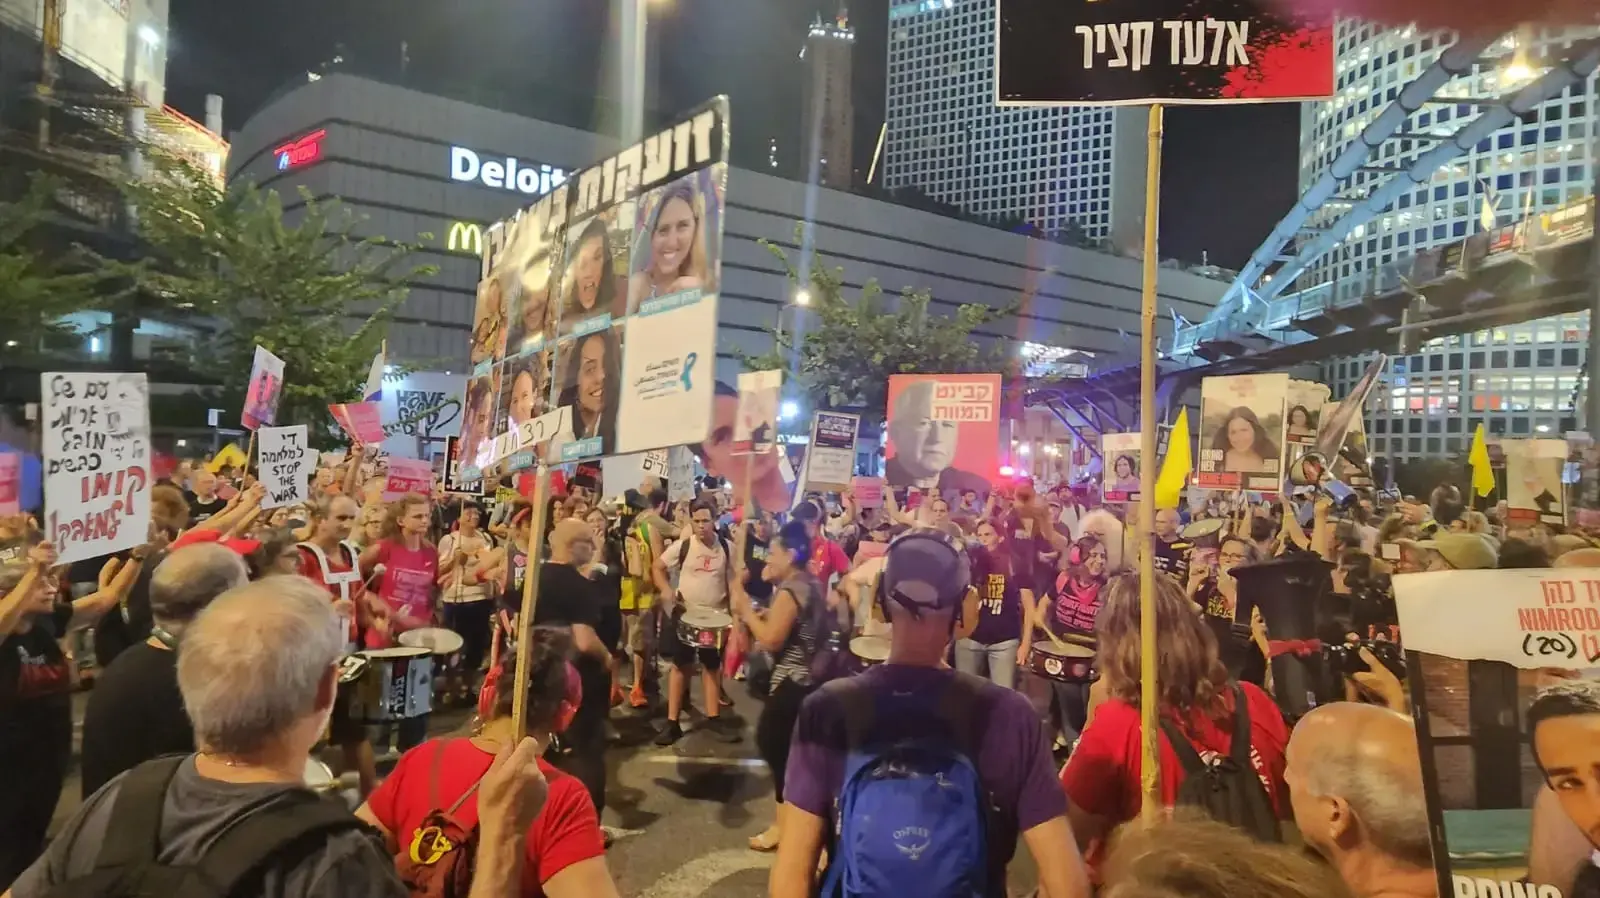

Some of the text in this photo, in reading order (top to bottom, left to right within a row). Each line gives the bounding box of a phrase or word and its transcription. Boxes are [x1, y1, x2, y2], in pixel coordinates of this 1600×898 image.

[1074, 17, 1250, 71] אלעד קציר
[573, 109, 714, 217] זועקות
[51, 374, 110, 400] עם של
[935, 384, 990, 400] קבינט
[934, 404, 989, 420] המוות
[281, 432, 298, 446] די
[261, 444, 305, 464] למלחמה
[271, 460, 302, 477] STOP
[80, 465, 147, 516] קומו
[277, 474, 296, 487] THE
[270, 485, 300, 504] WAR
[1539, 580, 1576, 607] כהן
[1517, 607, 1600, 632] NIMROD
[1522, 631, 1577, 660] (20)
